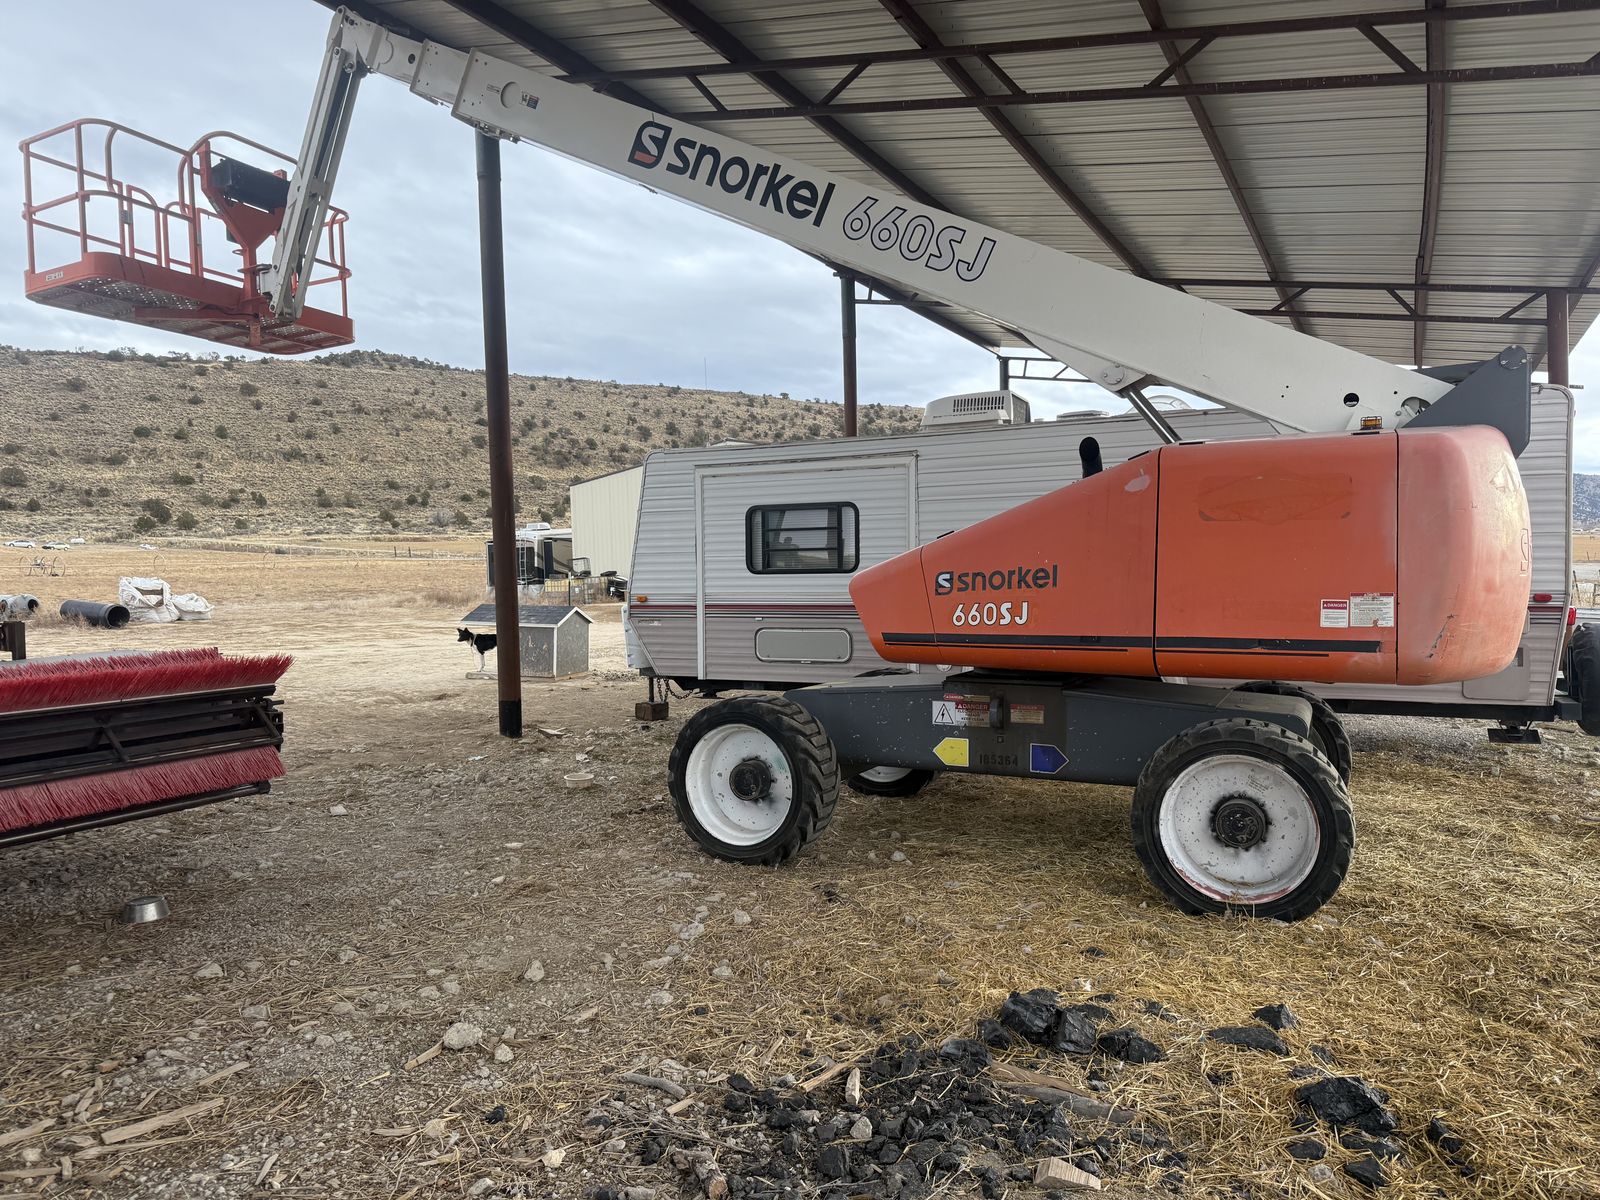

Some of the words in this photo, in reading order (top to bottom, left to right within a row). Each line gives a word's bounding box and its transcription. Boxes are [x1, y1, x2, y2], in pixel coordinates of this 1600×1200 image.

[665, 137, 836, 227] snorkel
[842, 195, 997, 282] 660SJ
[957, 564, 1058, 593] snorkel
[952, 601, 1030, 627] 660SJ
